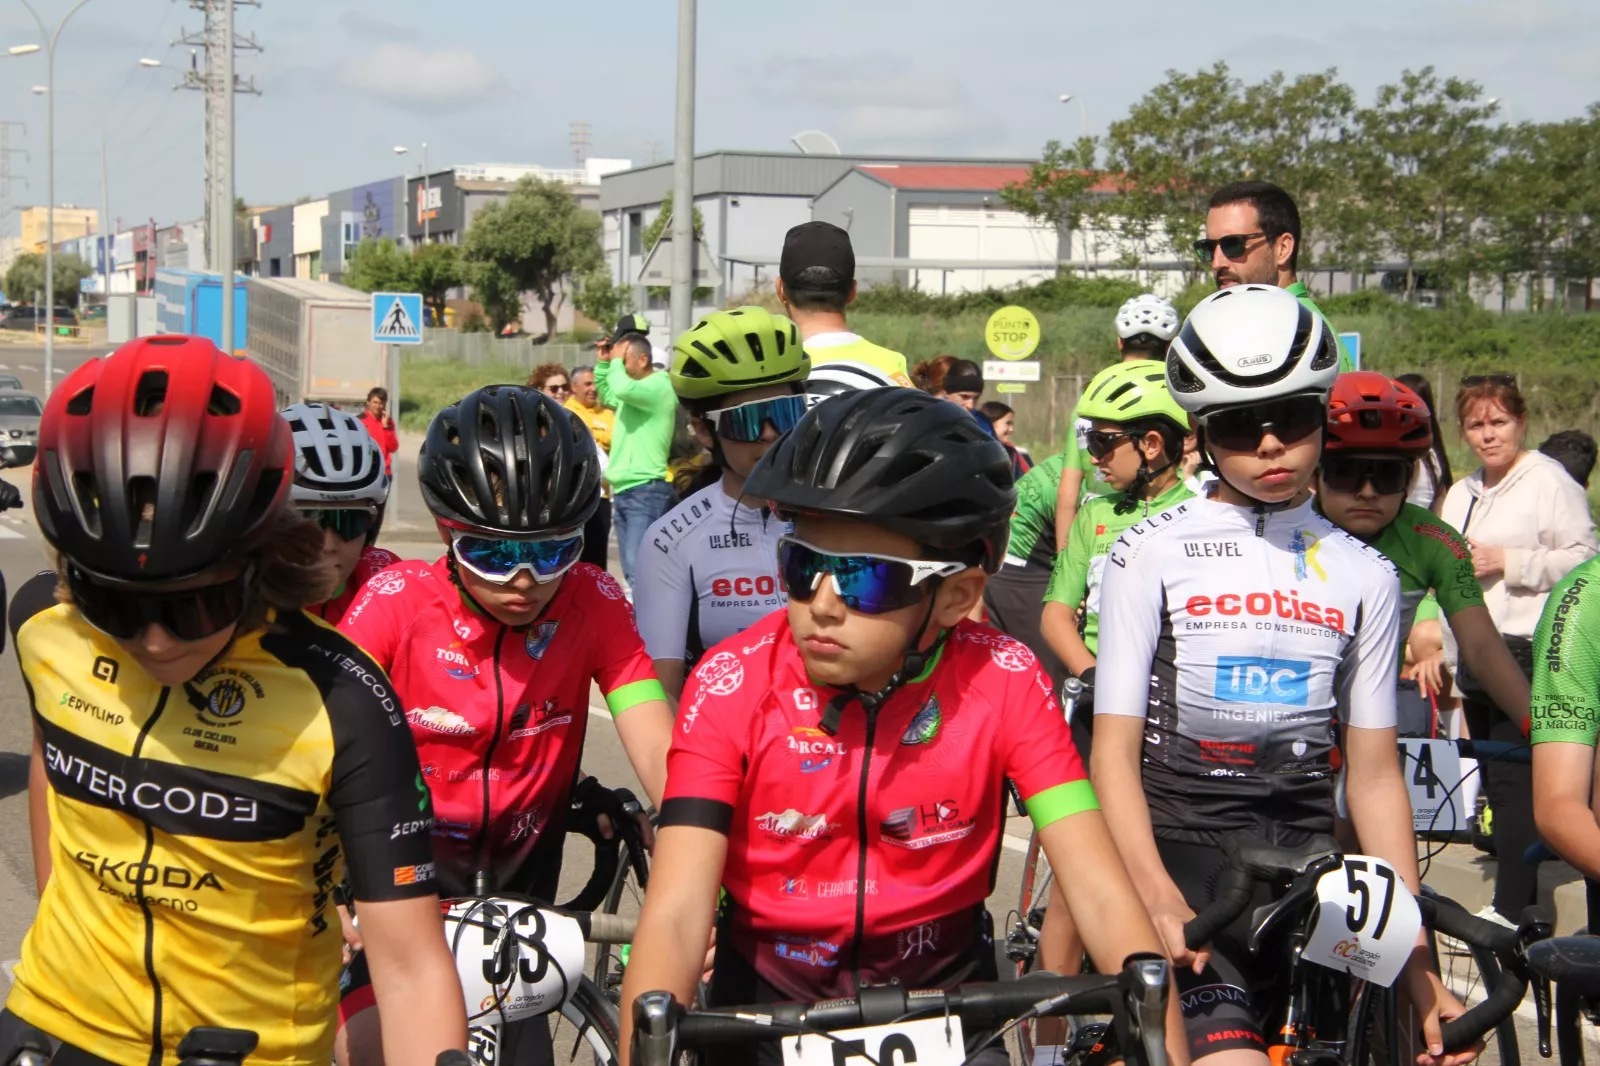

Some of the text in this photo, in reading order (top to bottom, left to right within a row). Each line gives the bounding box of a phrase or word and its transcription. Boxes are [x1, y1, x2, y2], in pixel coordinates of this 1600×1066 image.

[993, 321, 1030, 330] PUNTO
[993, 332, 1028, 342] STOP
[653, 497, 712, 554] CYCLON
[1111, 504, 1188, 569] CYCLON
[711, 600, 760, 608] EMPRESA
[1185, 588, 1346, 635] ecotisa
[1185, 621, 1344, 641] EMPRESA CONSTRUCTORA
[1546, 576, 1589, 673] altoaragon
[1231, 665, 1297, 697] IDC
[59, 690, 125, 727] SERVYLIMP
[1531, 701, 1597, 723] uesca
[1343, 859, 1396, 941] 57
[508, 1000, 543, 1010] ciclismo
[515, 992, 545, 1003] aragón
